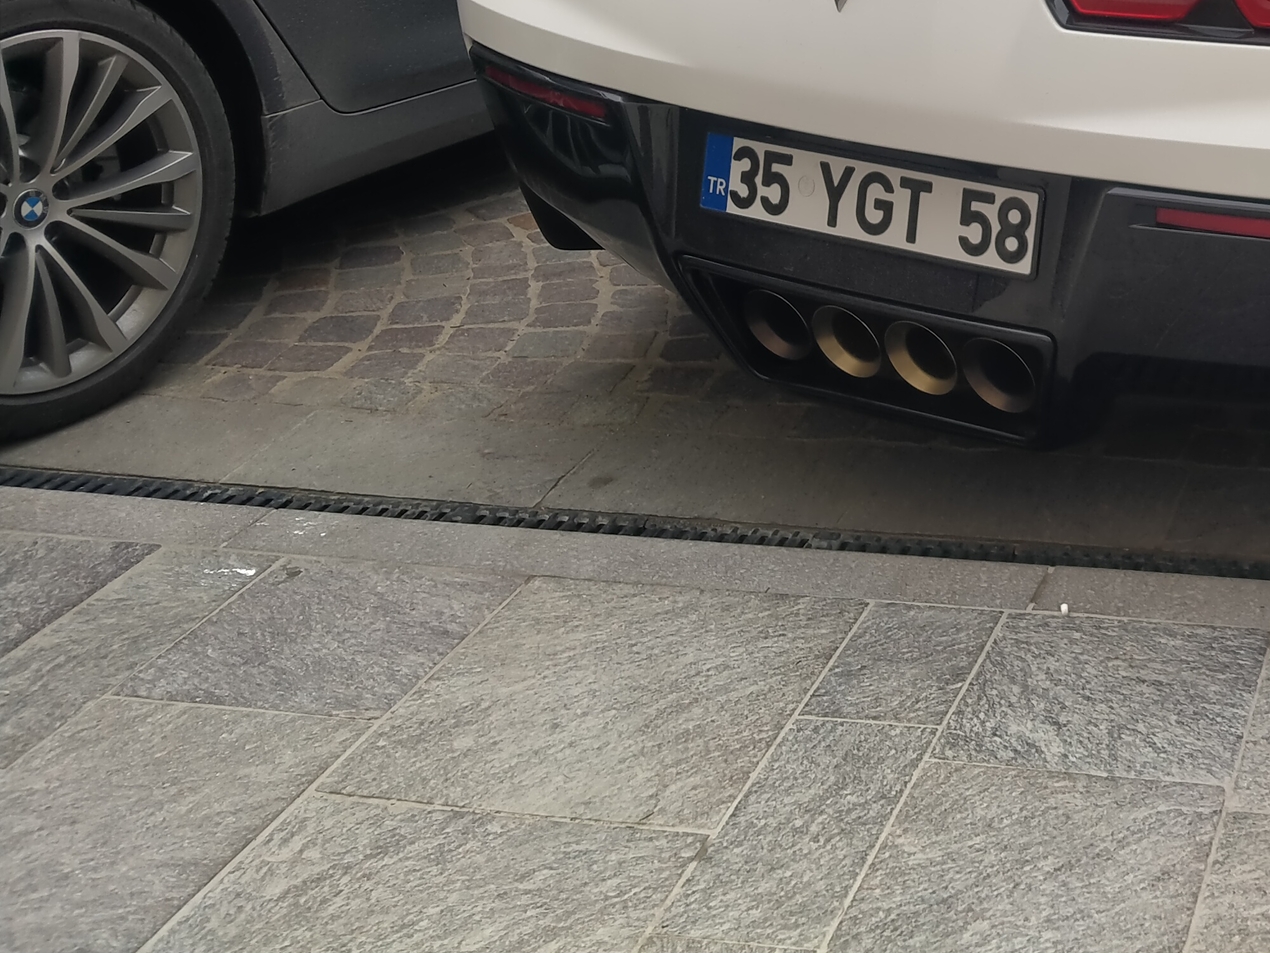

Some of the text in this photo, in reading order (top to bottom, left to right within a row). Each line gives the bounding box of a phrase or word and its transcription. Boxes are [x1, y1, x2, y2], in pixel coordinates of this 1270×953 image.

[707, 176, 727, 196] TR
[729, 145, 1032, 265] 35 YGT 58
